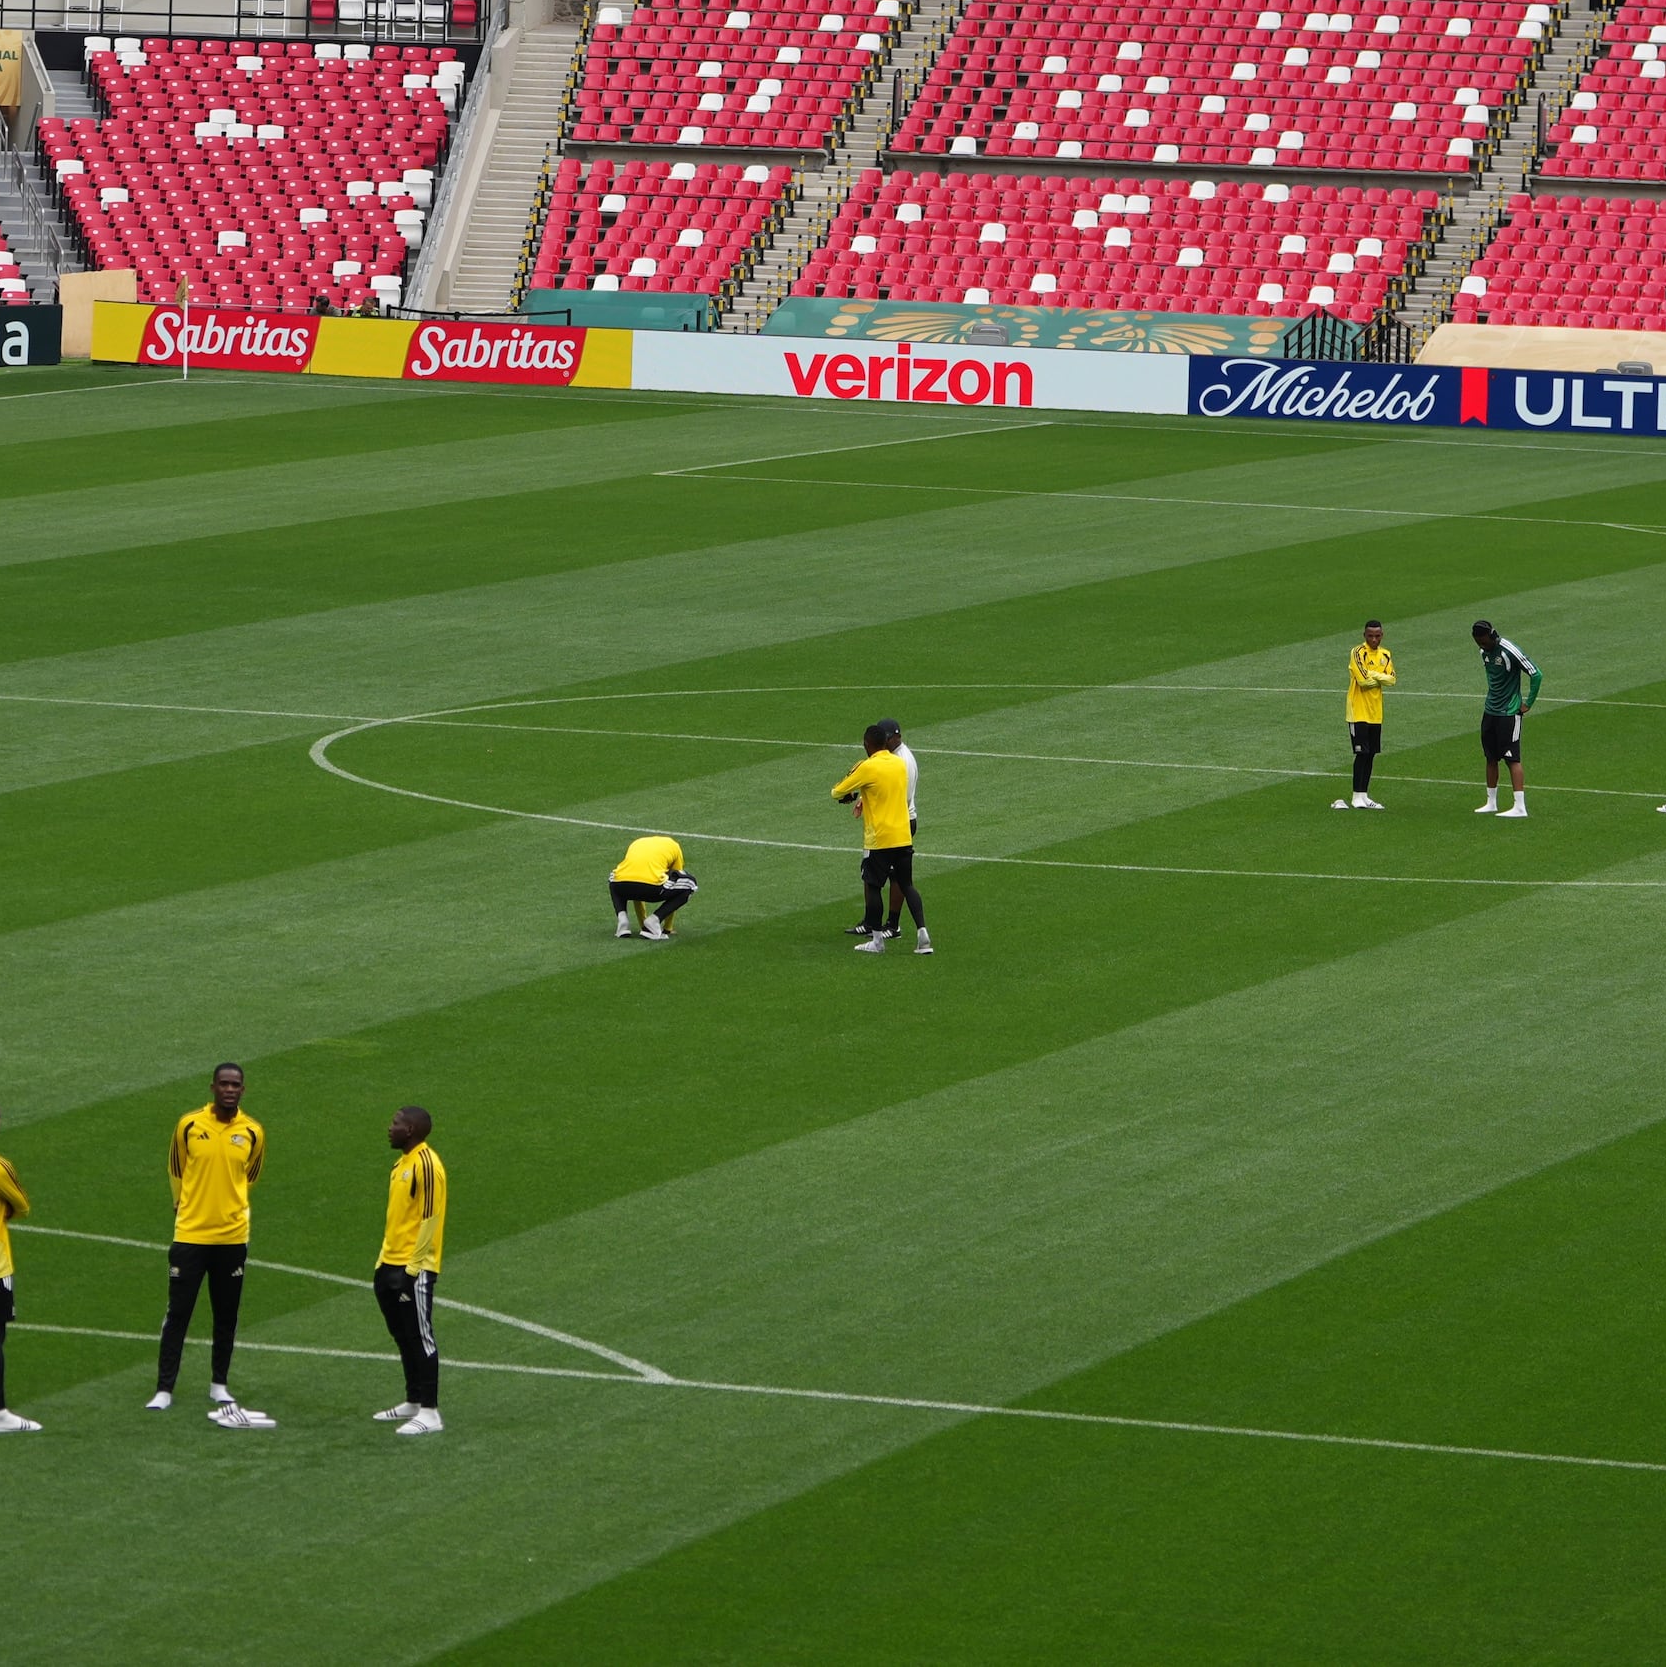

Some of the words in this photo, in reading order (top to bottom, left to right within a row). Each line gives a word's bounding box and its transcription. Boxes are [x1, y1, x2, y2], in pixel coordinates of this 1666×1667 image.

[146, 311, 310, 361] Sabritas
[411, 326, 576, 376] Sabritas
[783, 342, 1033, 406] verizon
[1198, 358, 1440, 422] Michelob
